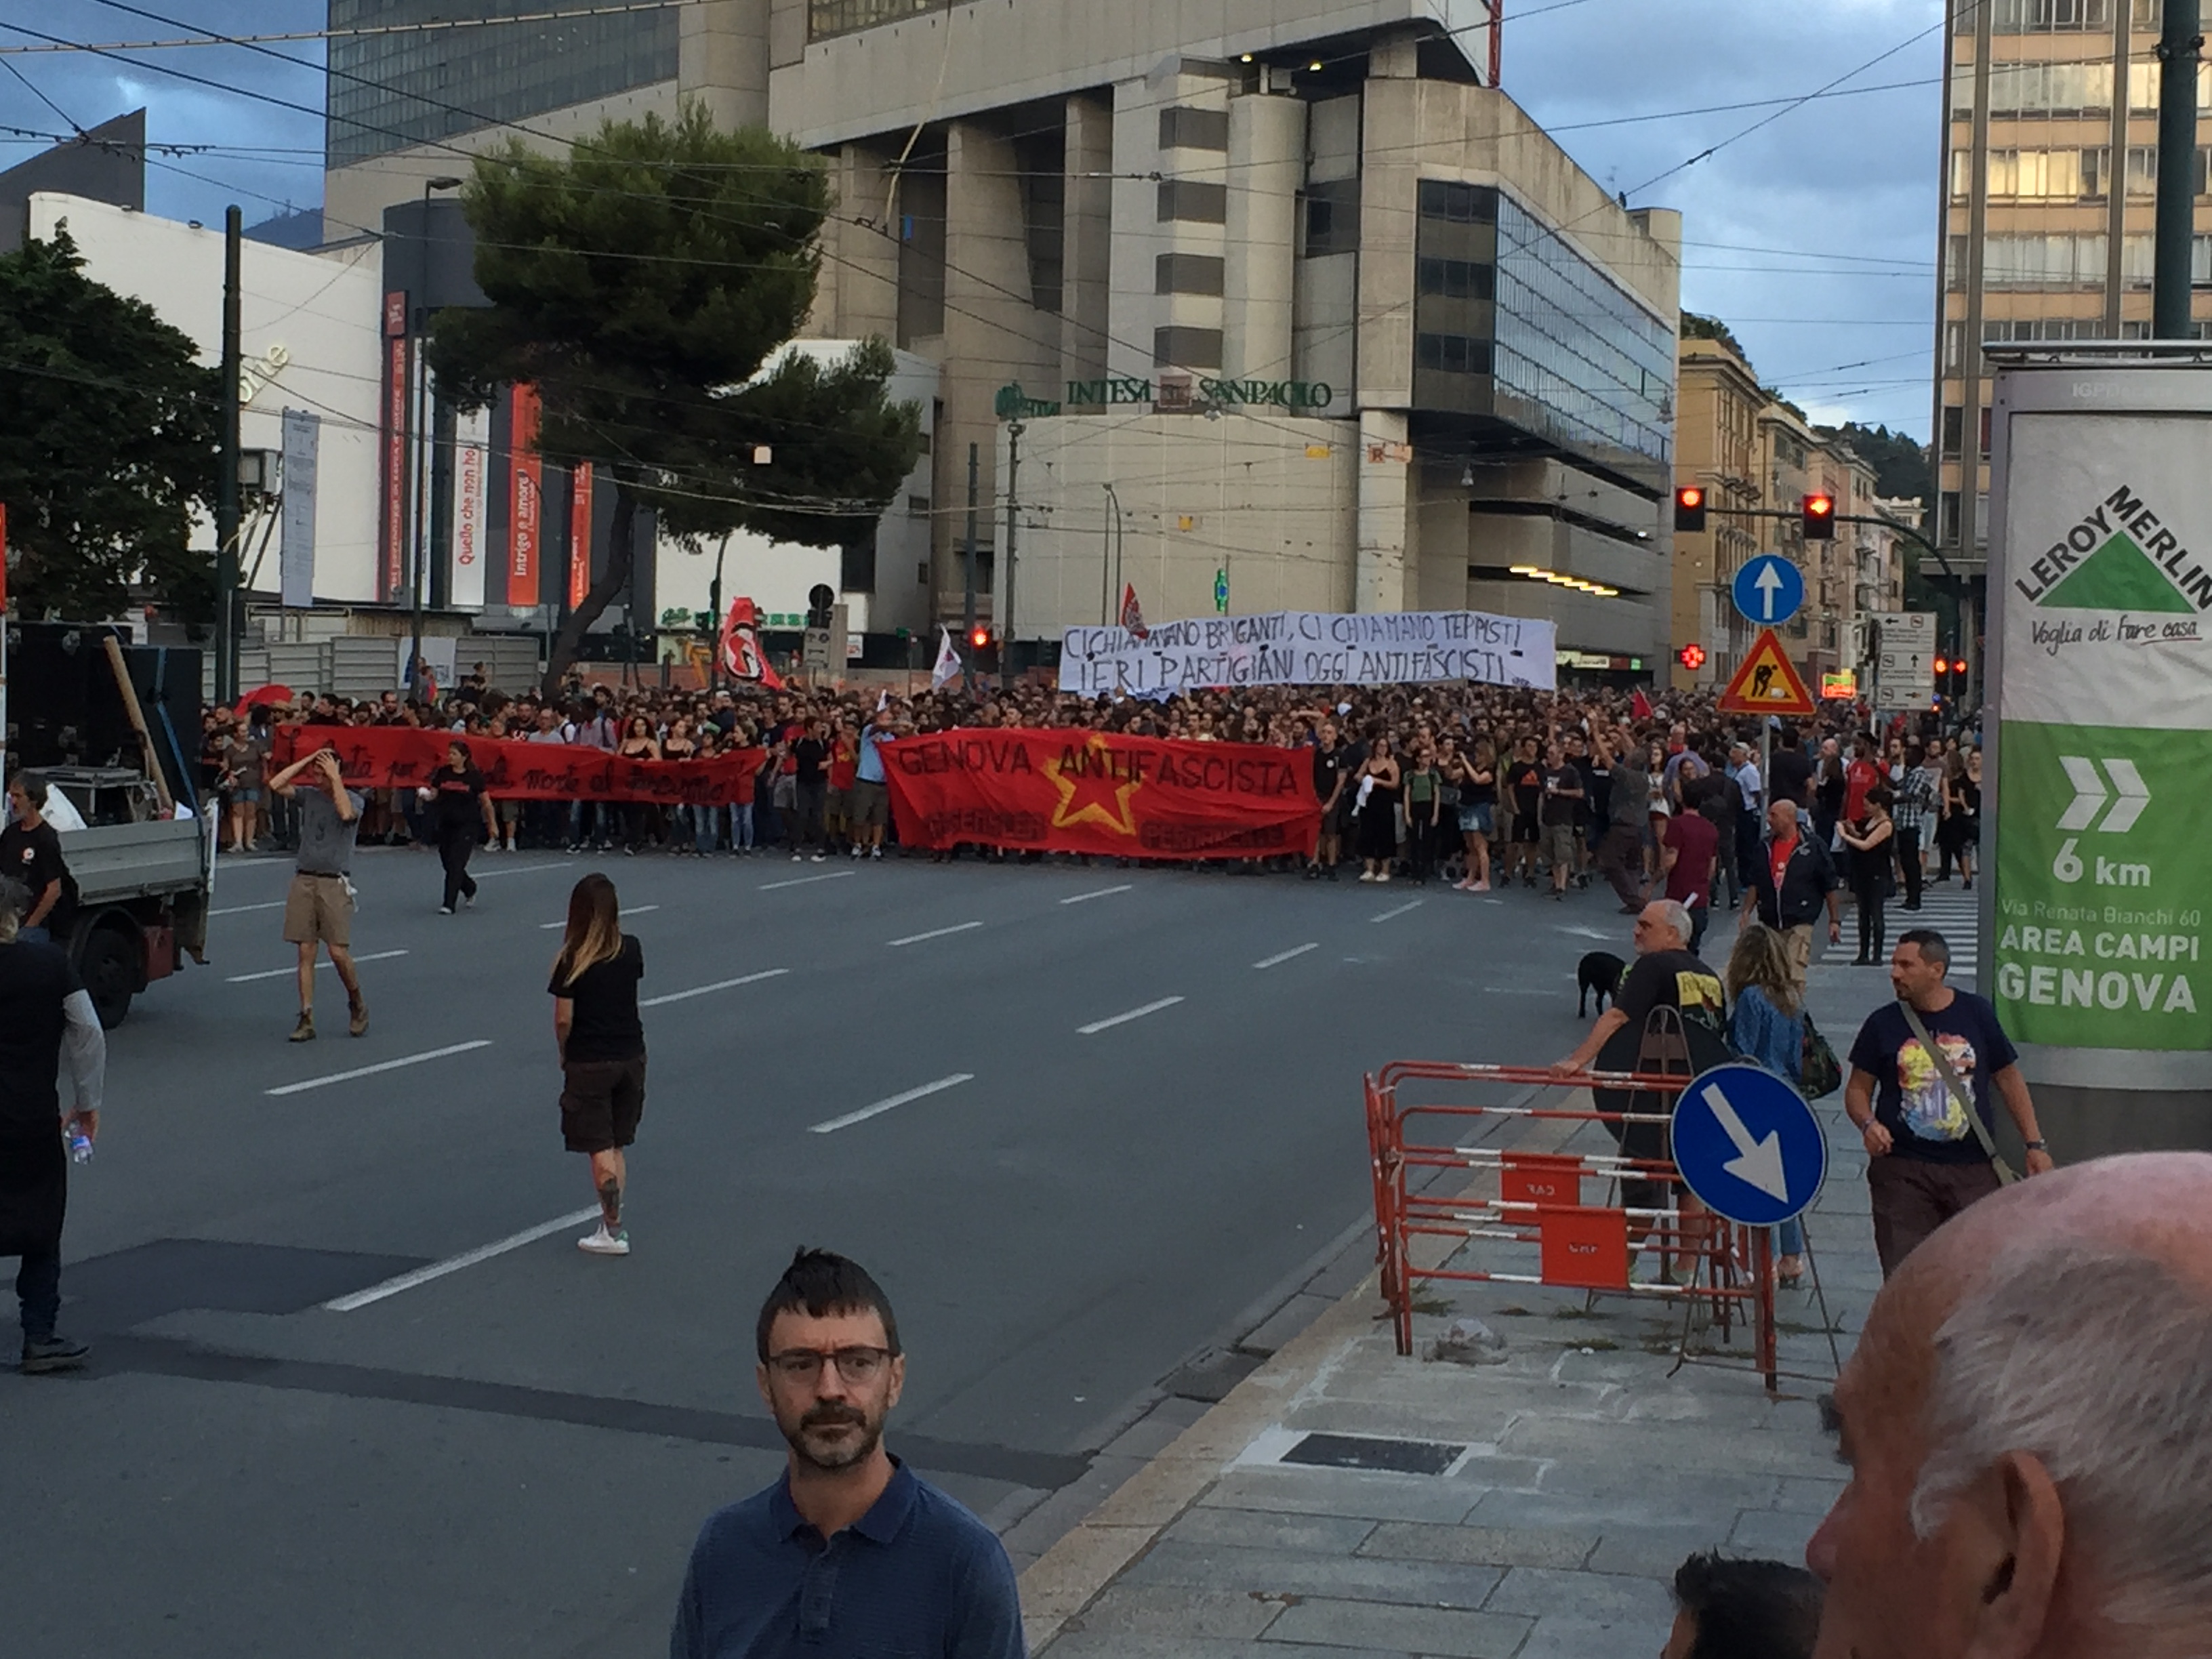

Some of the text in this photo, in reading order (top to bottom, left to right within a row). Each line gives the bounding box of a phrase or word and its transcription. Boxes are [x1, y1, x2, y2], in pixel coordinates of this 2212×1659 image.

[1067, 379, 1151, 405] INTESA
[1198, 380, 1332, 408] SANPAOLO
[458, 449, 476, 565] Quello che non ho
[517, 476, 529, 518] amore
[514, 533, 531, 576] Intrigo
[2015, 485, 2212, 611] LEROY MERLIN
[1206, 613, 1294, 649] BRIGANTI,
[1299, 613, 1322, 640] CI
[1332, 615, 1435, 642] CHIAMANO
[1439, 613, 1521, 648] TEPPISTI
[2032, 621, 2082, 656] Voglia
[2088, 621, 2110, 641] di
[2162, 621, 2198, 638] casa
[1081, 649, 1504, 691] IERI PARTIGIANI OGGI ANTIFASCISTI
[899, 740, 1298, 795] GENOVA ANTIFASCISTA
[2053, 838, 2151, 887] 6 km
[2002, 899, 2200, 927] Via Renata Bianchi 60
[2000, 924, 2199, 961] AREA CAMPI
[1999, 962, 2198, 1013] GENOVA
